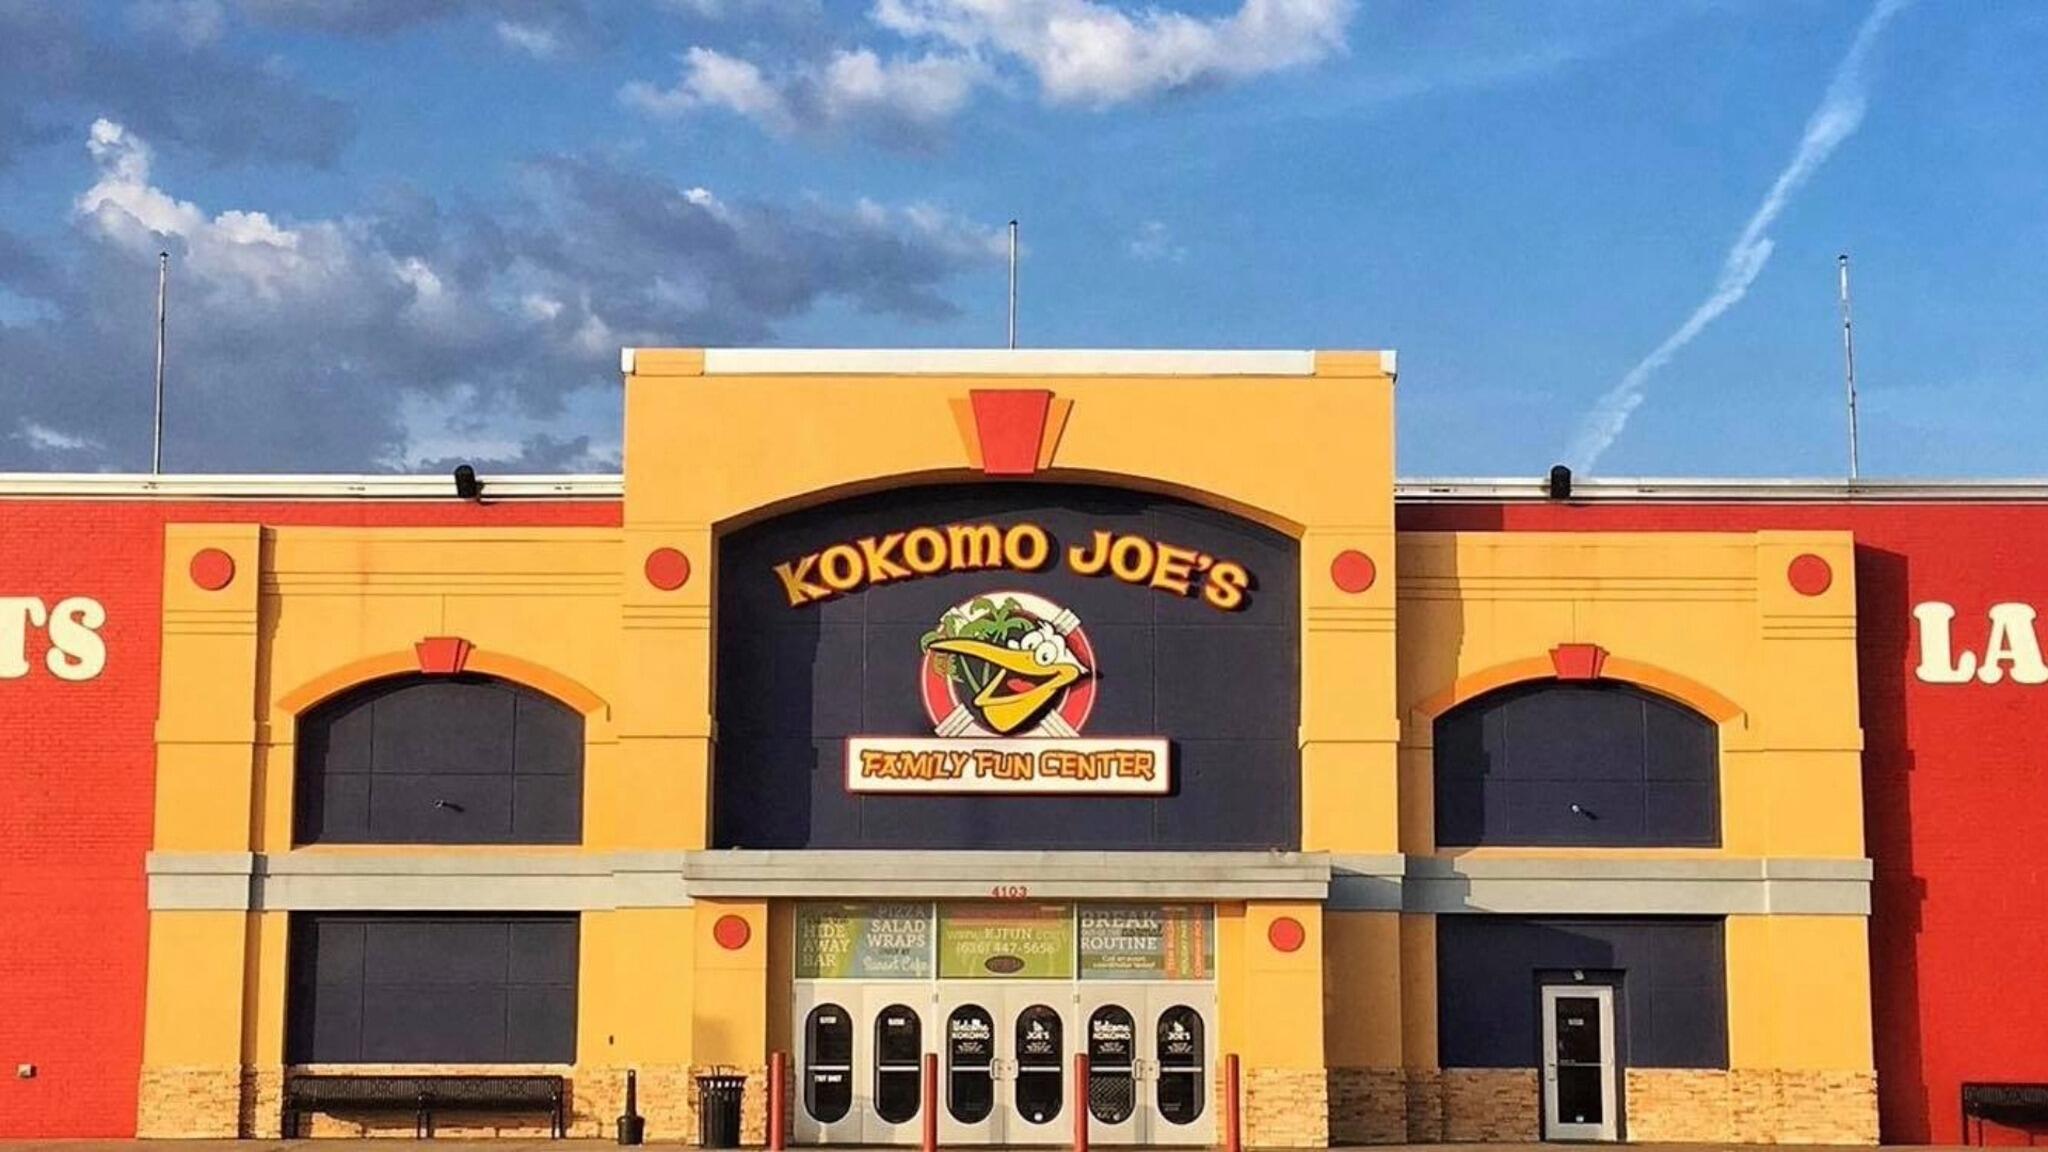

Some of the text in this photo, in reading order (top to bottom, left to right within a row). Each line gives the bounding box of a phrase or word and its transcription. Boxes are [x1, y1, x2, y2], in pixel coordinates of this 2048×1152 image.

[774, 522, 1253, 612] KOKOMO JOE'S
[1912, 601, 2048, 685] LA
[860, 750, 1156, 781] FAMILY FUN CENTER
[991, 886, 1028, 898] 4103
[878, 904, 926, 918] PIZZA
[870, 918, 926, 933] SALAD
[1082, 911, 1159, 928] BREAK
[803, 921, 843, 937] HIDE
[866, 932, 926, 948] WRAPS
[1081, 936, 1158, 950] ROUTINE
[803, 950, 833, 967] BAR
